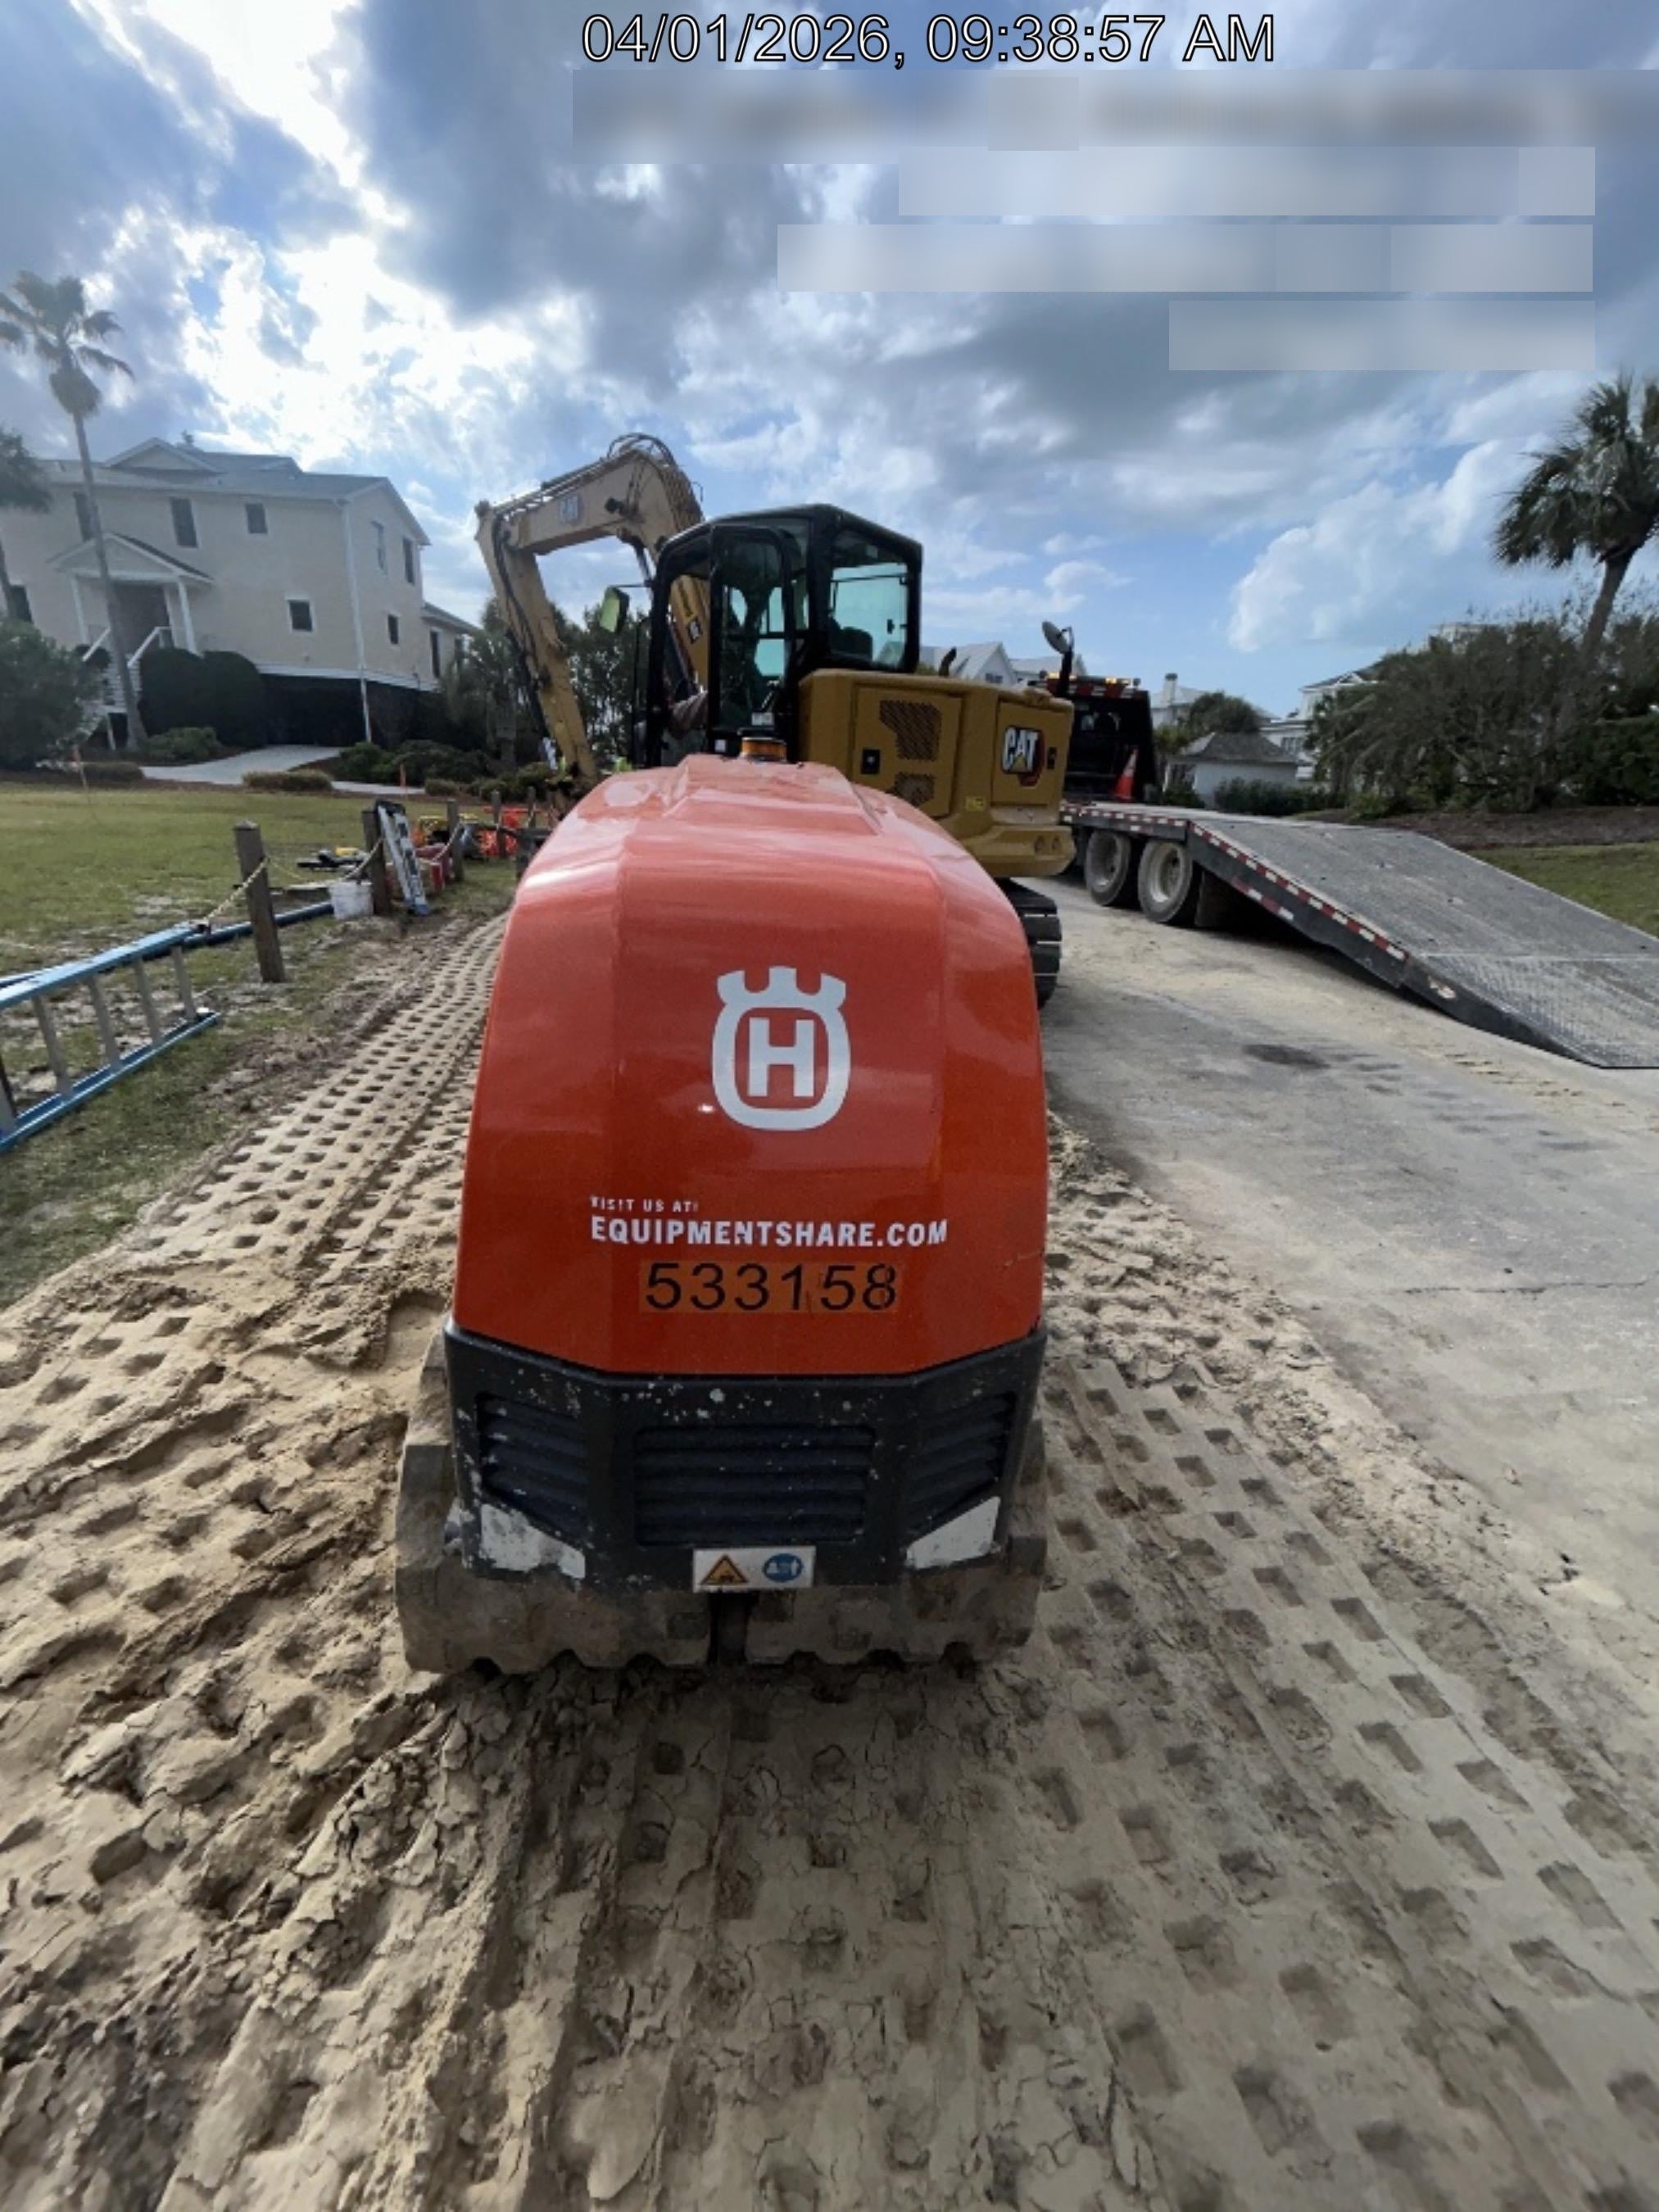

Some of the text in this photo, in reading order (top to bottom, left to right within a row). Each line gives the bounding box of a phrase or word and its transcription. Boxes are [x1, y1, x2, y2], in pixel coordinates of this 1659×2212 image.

[1002, 727, 1039, 771] CAT
[642, 1199, 664, 1213] US
[591, 1215, 949, 1247] EQUIPMENTSHARE.COM
[645, 1262, 897, 1311] 533158
